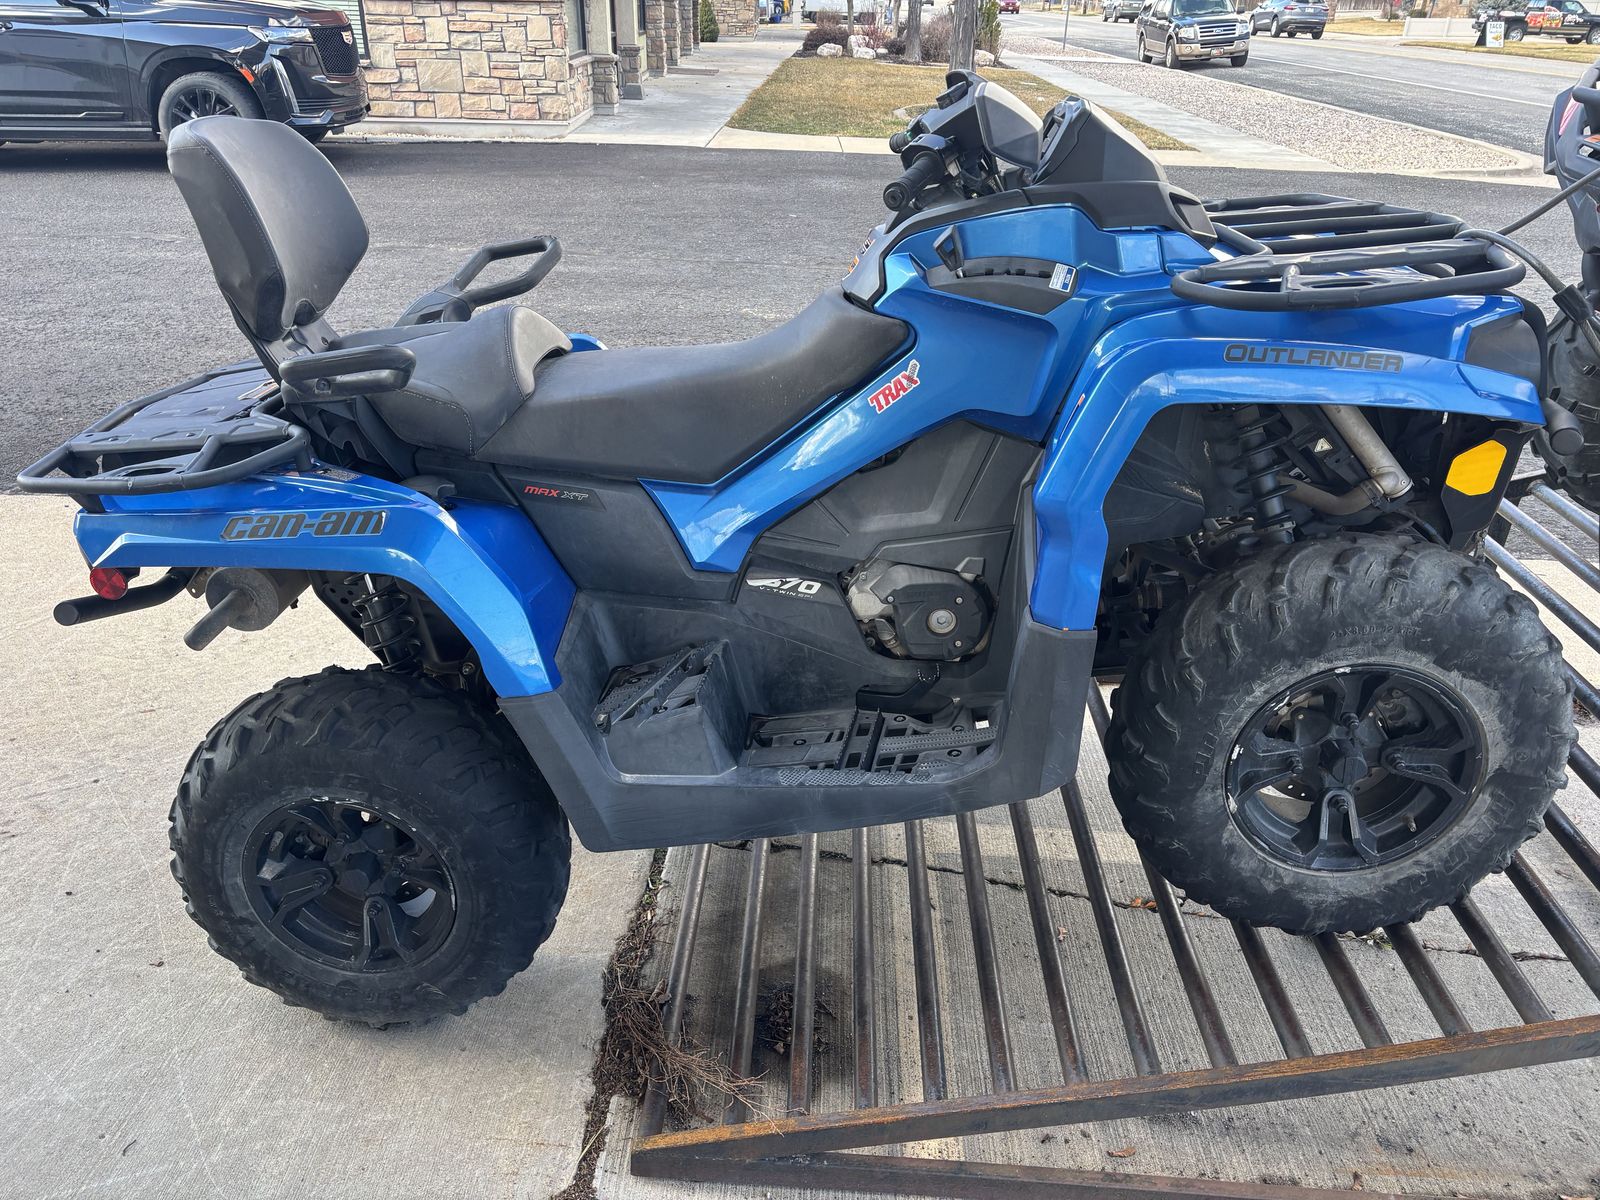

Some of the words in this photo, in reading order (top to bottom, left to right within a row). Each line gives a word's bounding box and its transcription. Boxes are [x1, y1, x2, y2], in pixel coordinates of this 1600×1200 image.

[1224, 343, 1404, 373] OUTLANDER
[524, 485, 560, 497] MAX
[561, 490, 589, 500] XT
